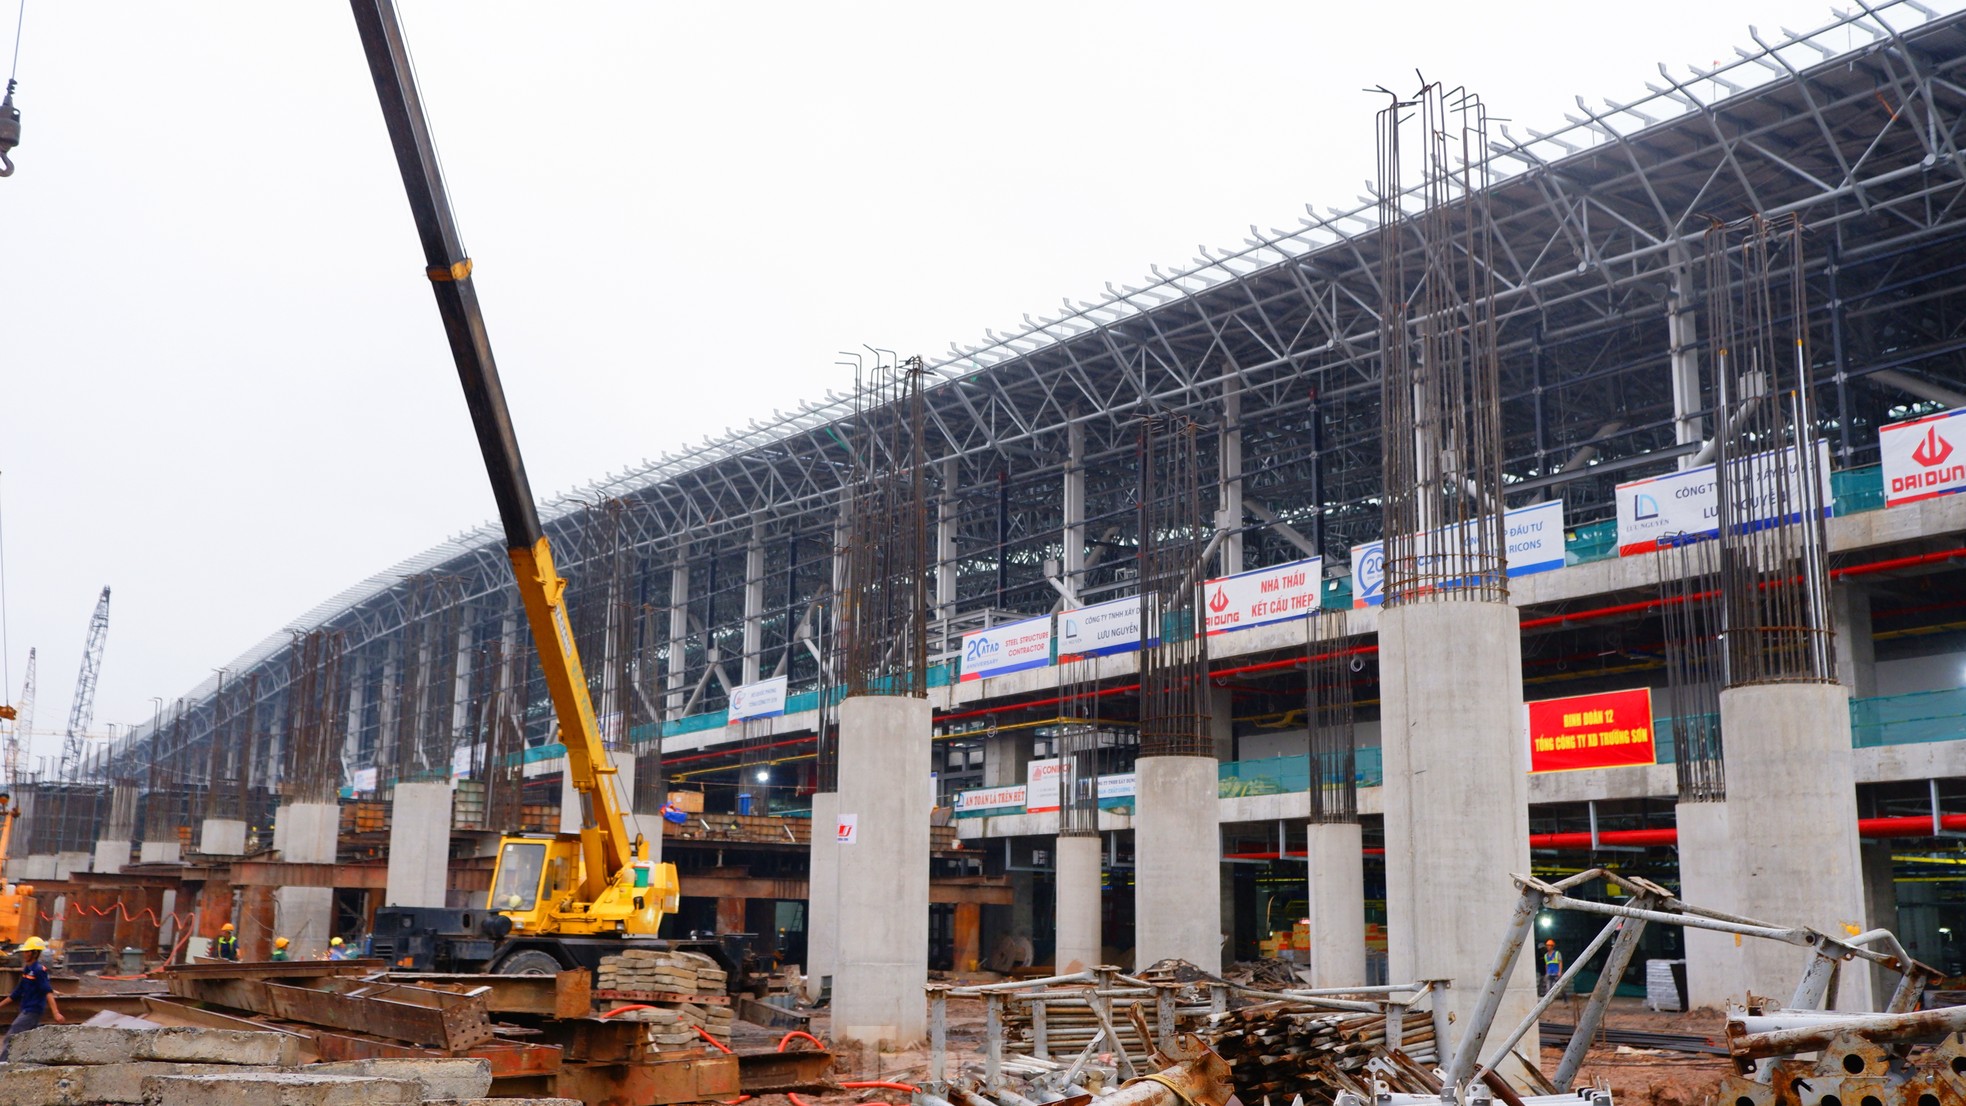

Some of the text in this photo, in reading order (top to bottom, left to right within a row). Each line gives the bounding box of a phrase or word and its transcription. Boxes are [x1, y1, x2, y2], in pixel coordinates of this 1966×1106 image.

[1925, 465, 1966, 486] DUN
[1676, 484, 1706, 499] CÔNG
[1531, 520, 1544, 533] TƯ
[1509, 540, 1542, 554] RICONS
[1260, 576, 1279, 593] NHÀ
[1251, 592, 1314, 617] KẾT CẤU THÉP
[1085, 615, 1100, 625] CÔNG
[1101, 614, 1107, 622] TY
[1108, 610, 1124, 620] TNHH
[1125, 607, 1135, 616] XÂY
[1005, 639, 1018, 647] STEEL
[1020, 631, 1049, 644] STRUCTURE
[982, 642, 999, 654] ATAD
[1008, 643, 1045, 657] CONTRACTOR
[1604, 709, 1614, 723] 12
[1555, 734, 1576, 750] CÔNG
[1577, 734, 1587, 748] TY
[1587, 733, 1598, 747] XD
[1631, 727, 1648, 743] SƠN
